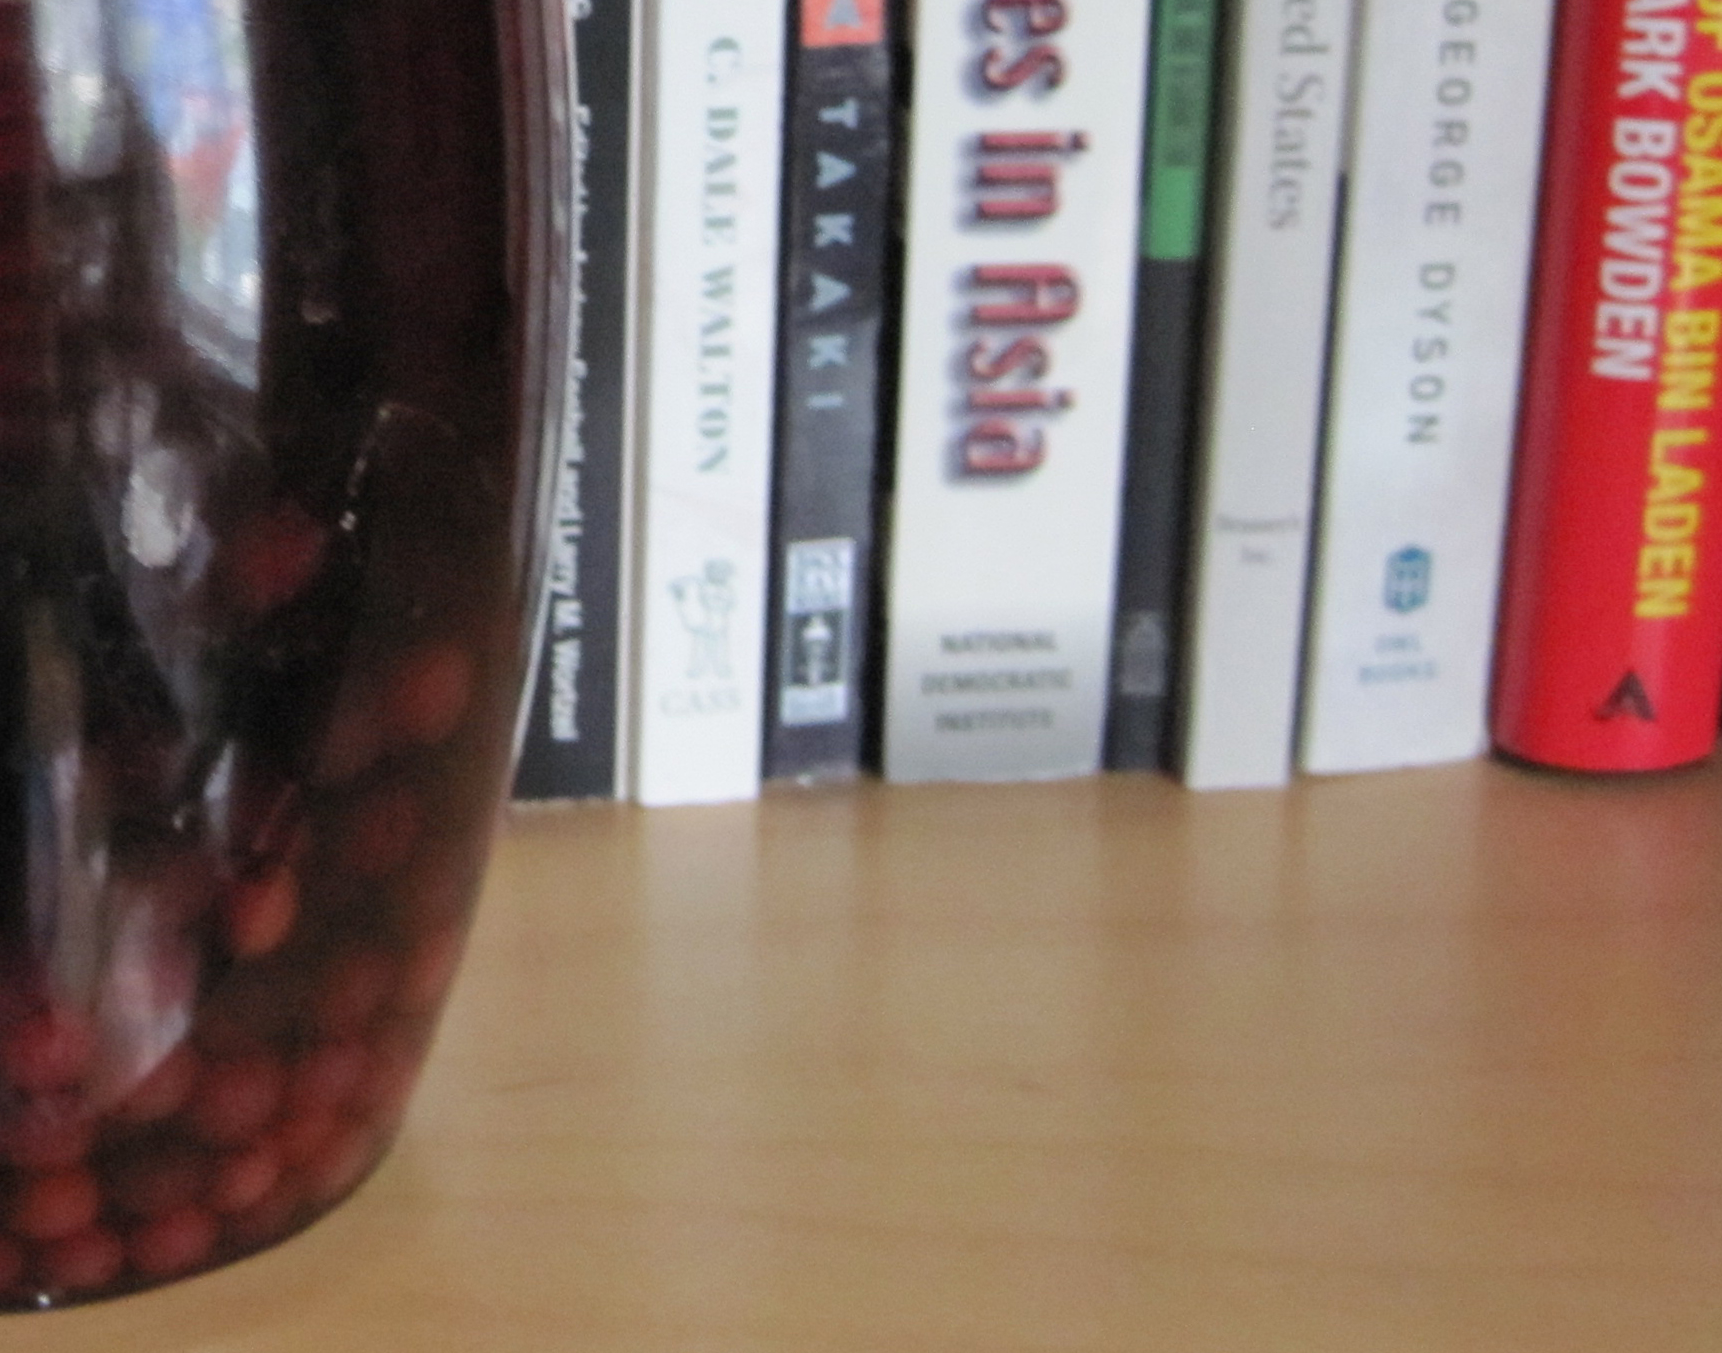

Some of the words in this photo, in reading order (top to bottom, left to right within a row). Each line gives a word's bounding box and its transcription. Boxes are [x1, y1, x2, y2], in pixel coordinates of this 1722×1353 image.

[705, 36, 743, 85] C.
[1269, 71, 1326, 232] States
[805, 96, 861, 411] TAKAKI
[968, 129, 1091, 224] in
[1589, 114, 1678, 382] BOWDEN
[696, 262, 737, 475] WALTON
[959, 261, 1085, 480] Asia
[1404, 260, 1456, 445] DYSON
[1655, 308, 1721, 412] BIN
[1632, 427, 1709, 620] LADEN
